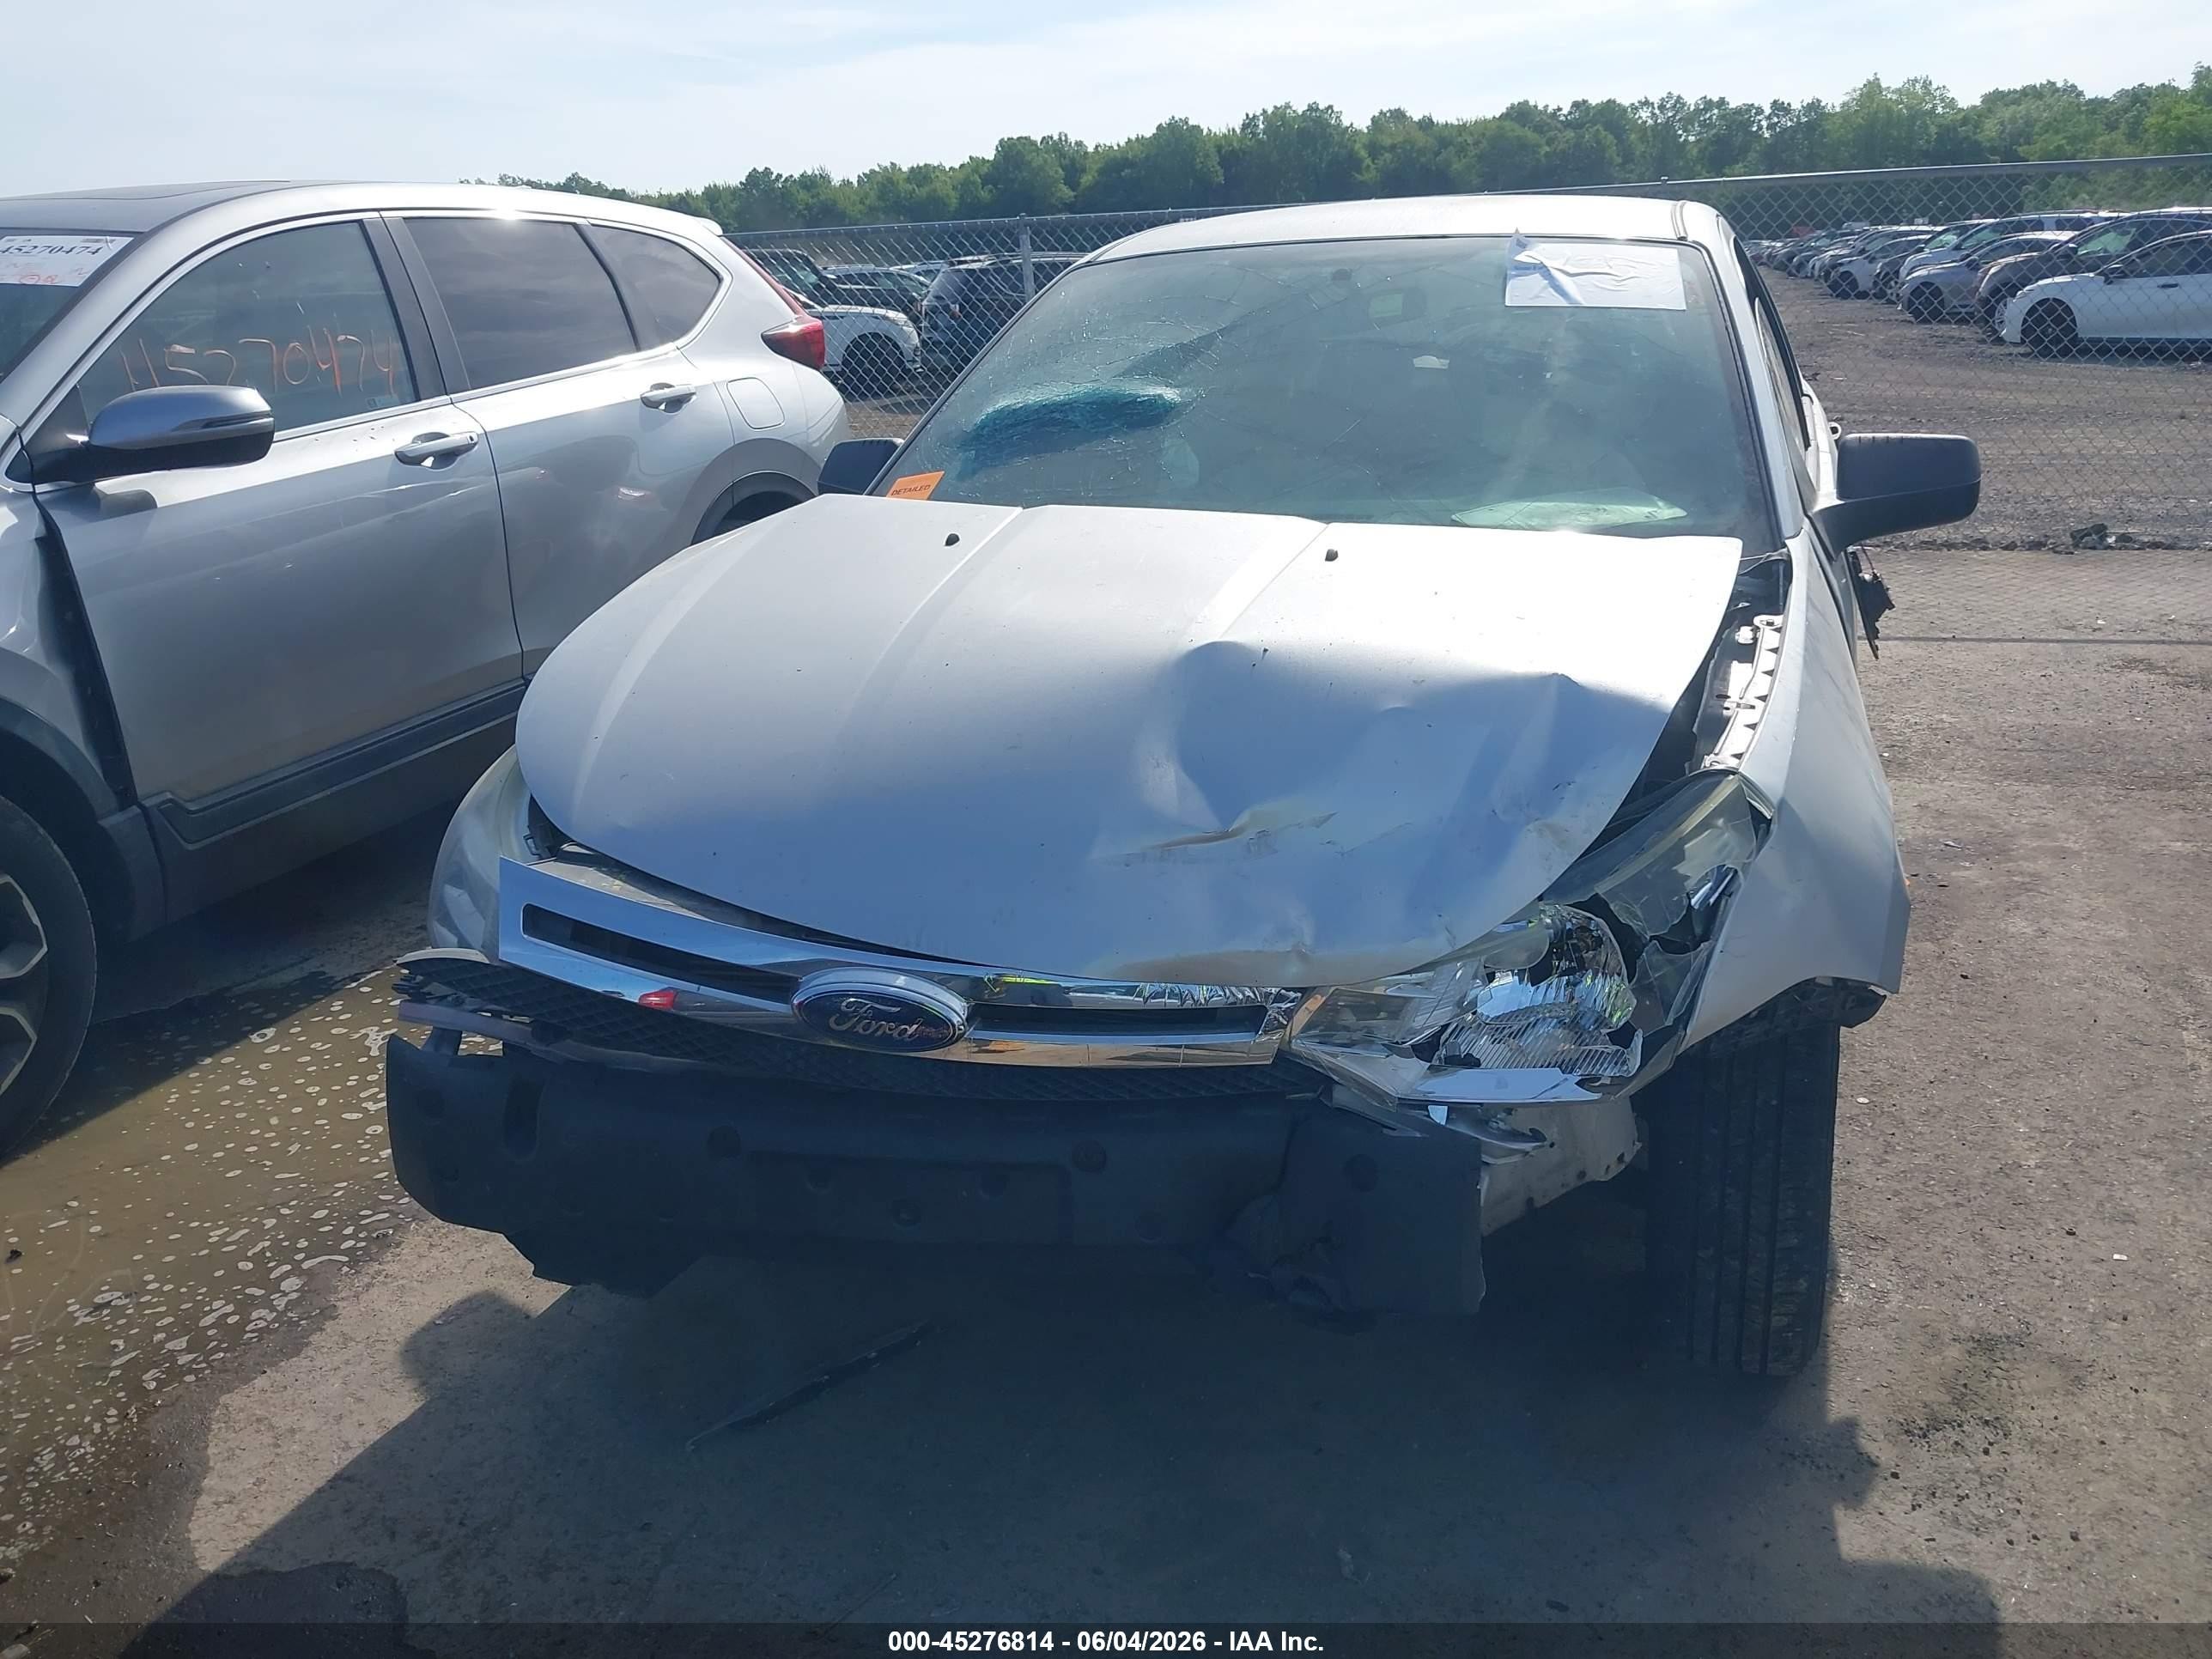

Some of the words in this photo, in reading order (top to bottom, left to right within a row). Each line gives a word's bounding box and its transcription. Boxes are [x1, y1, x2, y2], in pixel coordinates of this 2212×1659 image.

[0, 245, 104, 255] 45270474
[891, 485, 931, 495] DETAILED
[830, 998, 923, 1041] Ford
